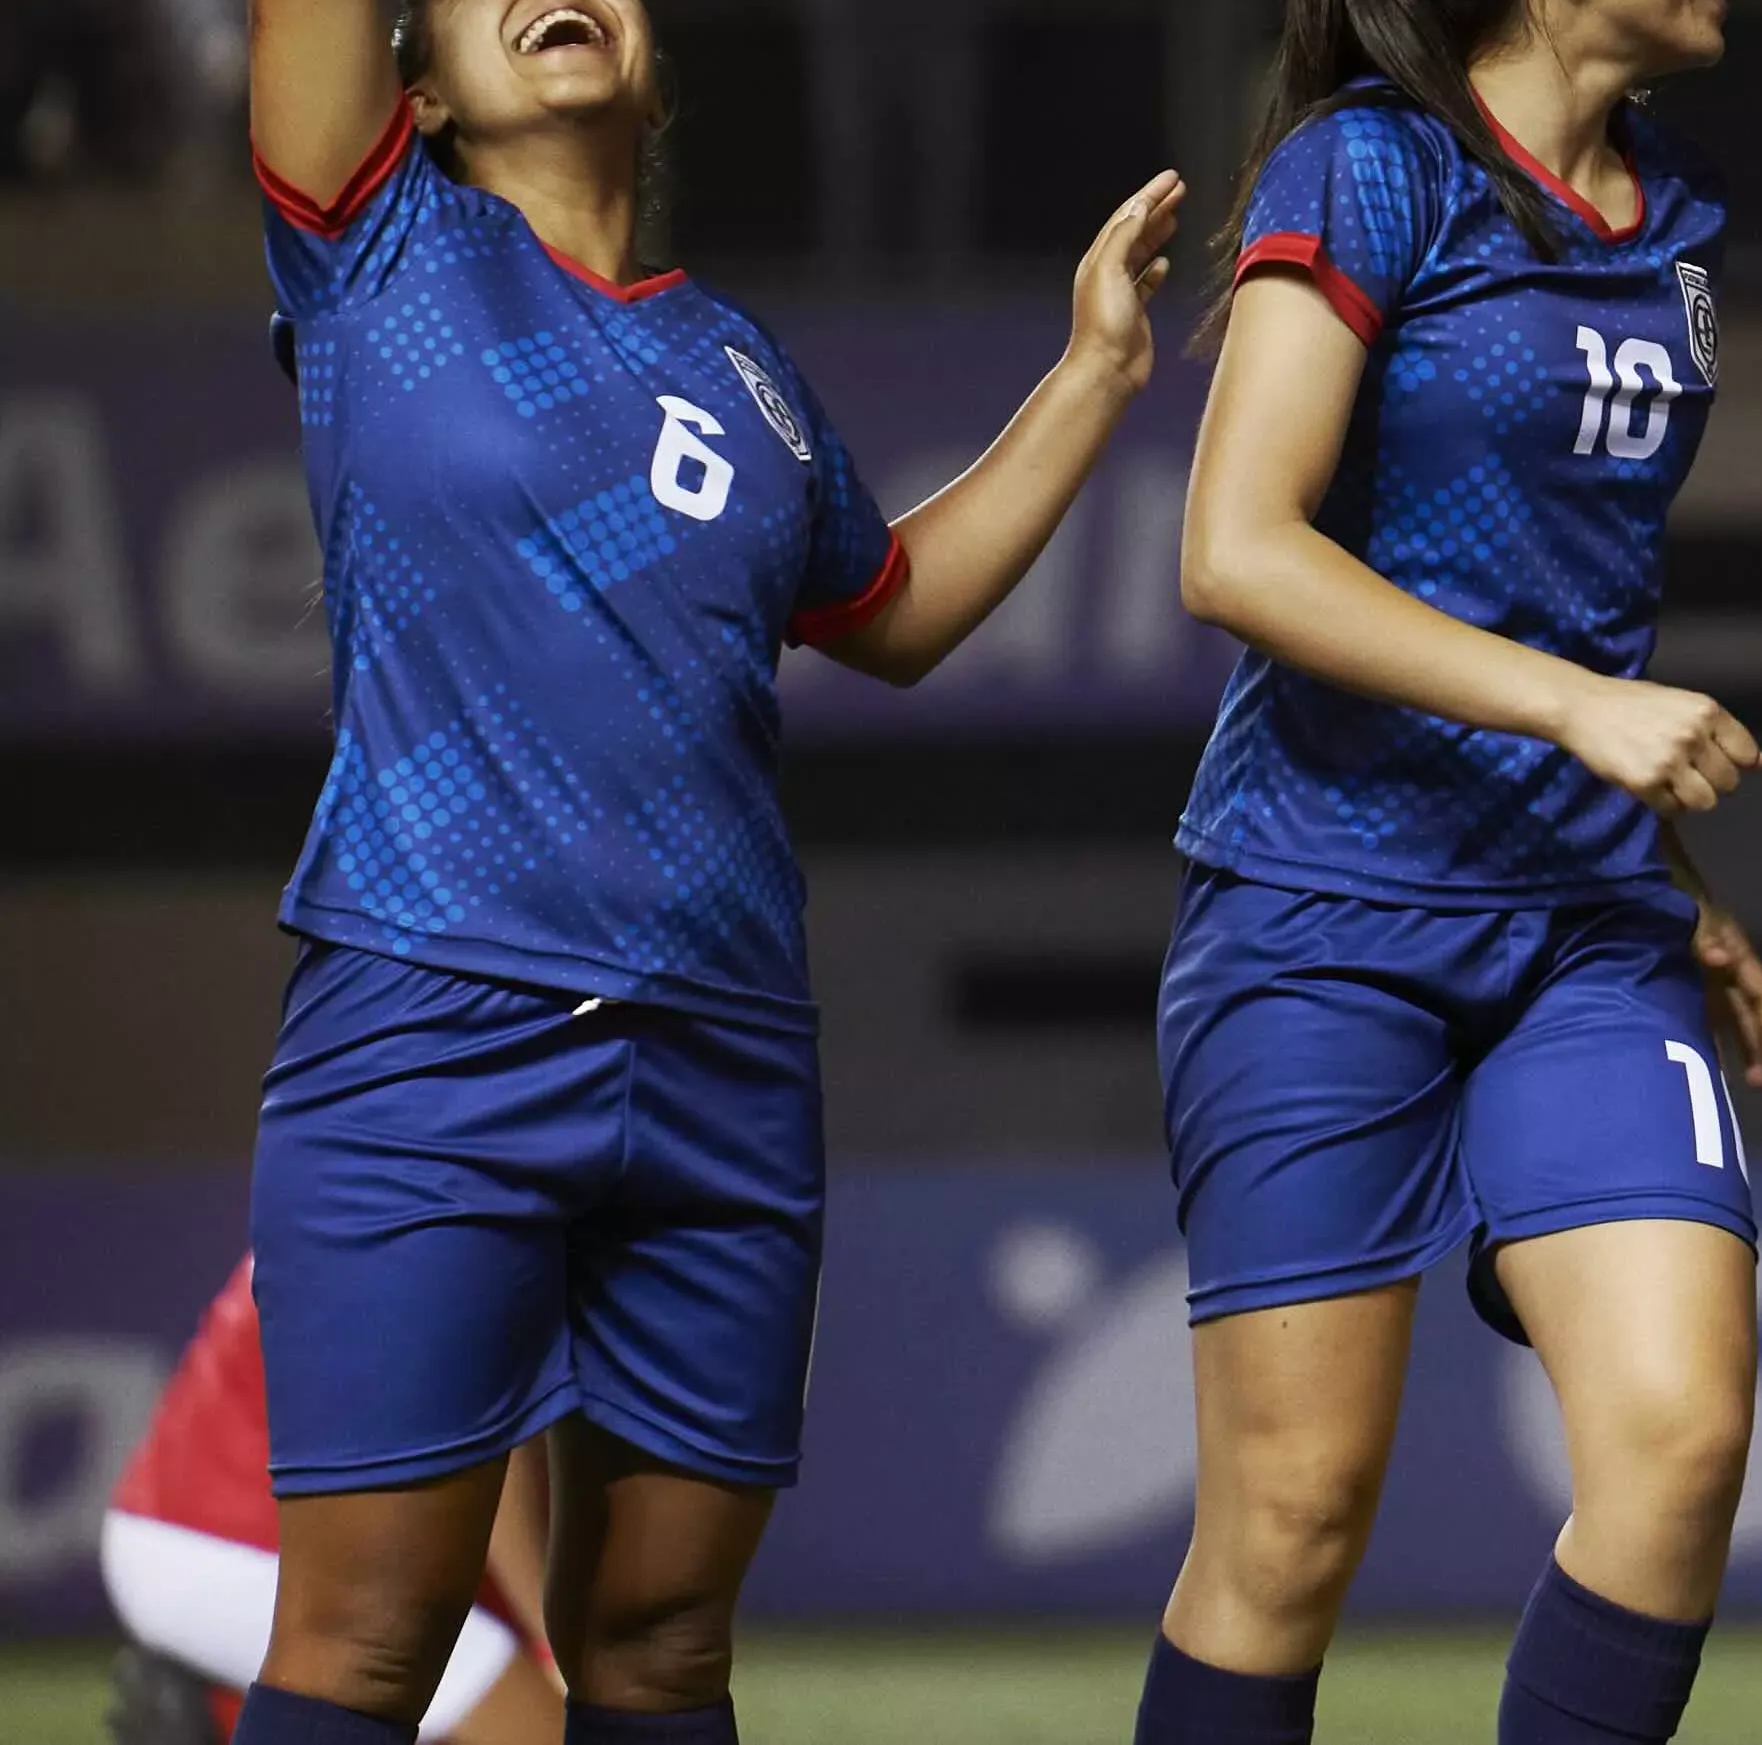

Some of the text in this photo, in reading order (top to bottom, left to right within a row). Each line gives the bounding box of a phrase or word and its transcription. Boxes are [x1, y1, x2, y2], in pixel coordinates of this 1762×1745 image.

[650, 395, 734, 521] 6
[1573, 325, 1683, 459] 10
[1664, 1039, 1751, 1188] 1
